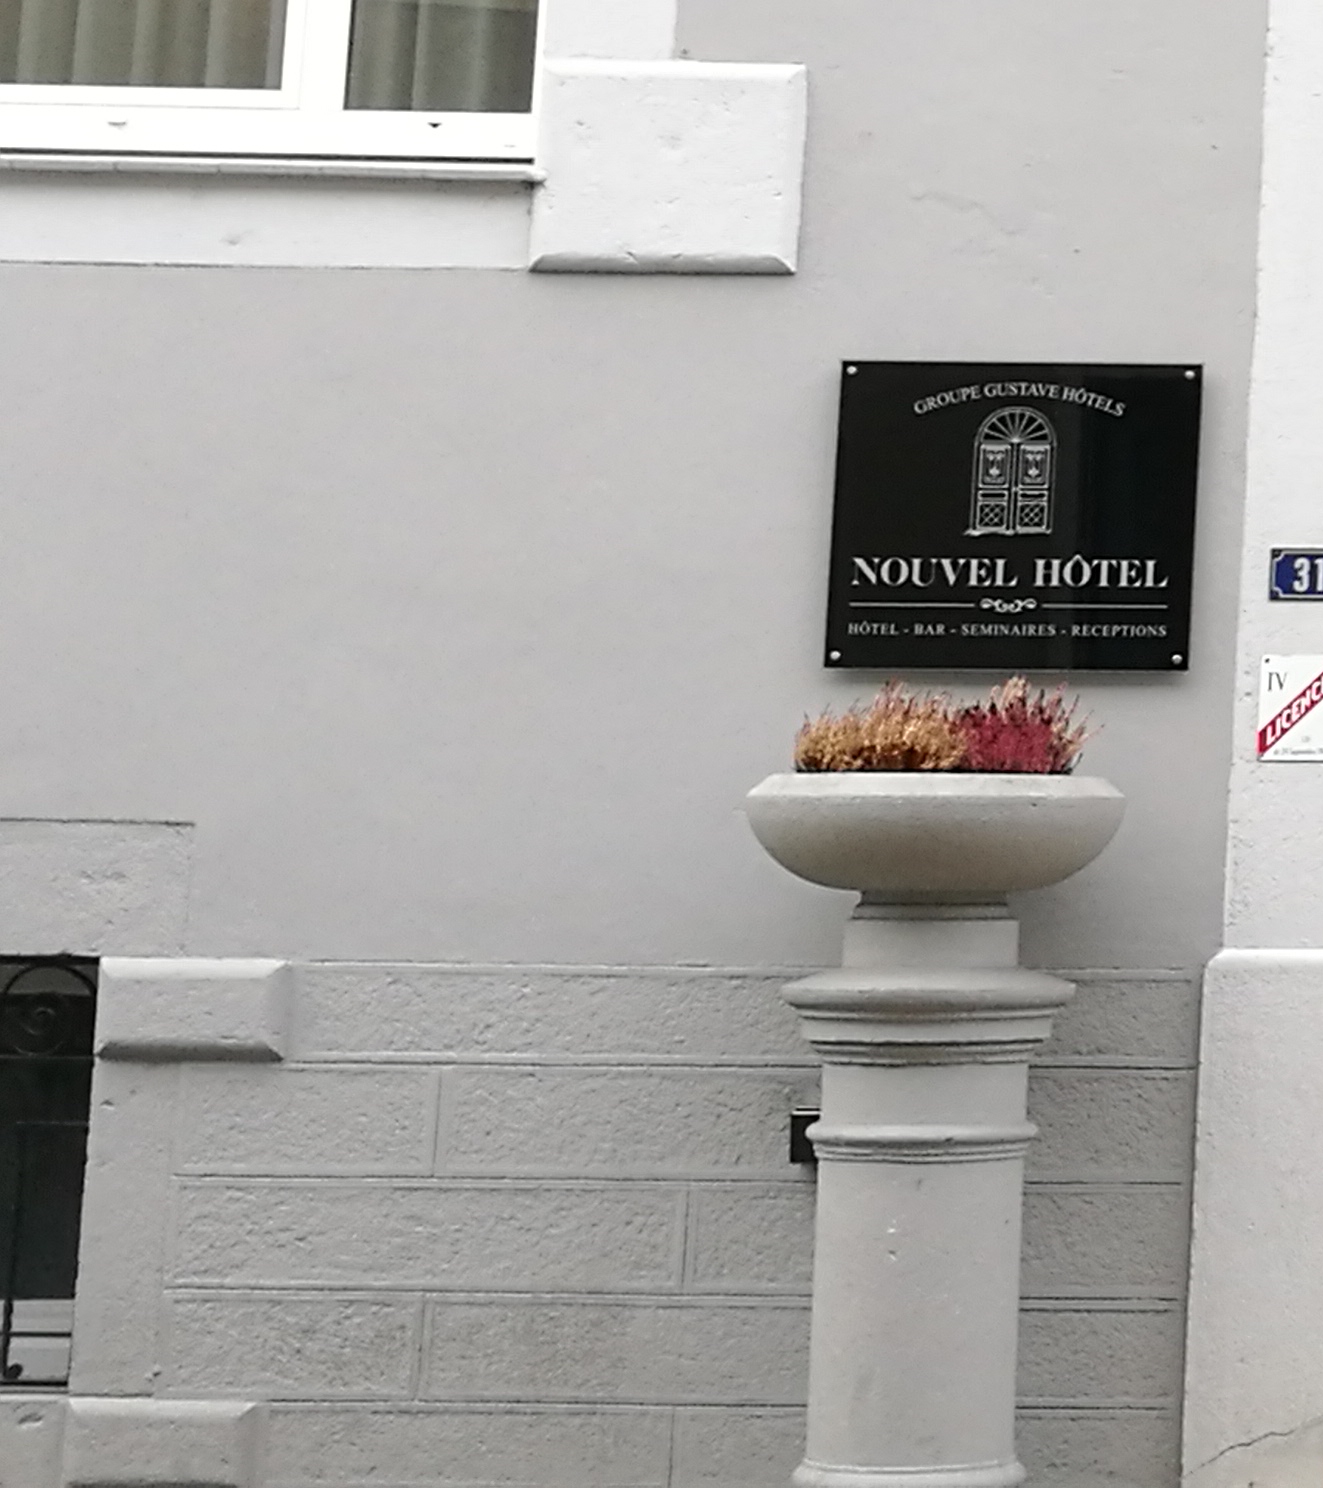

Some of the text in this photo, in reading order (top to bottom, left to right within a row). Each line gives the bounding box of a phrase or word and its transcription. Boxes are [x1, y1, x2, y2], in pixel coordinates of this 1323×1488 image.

[913, 381, 1125, 417] GROUPE GUSTAVE HÔTELS
[851, 554, 1168, 588] NOUVEL HÔTEL
[847, 620, 899, 636] HÔTEL
[914, 623, 945, 636] BAR
[961, 623, 1057, 637] SEMINAIRES
[1071, 624, 1167, 637] RECEPTIONS
[1267, 672, 1287, 692] IV
